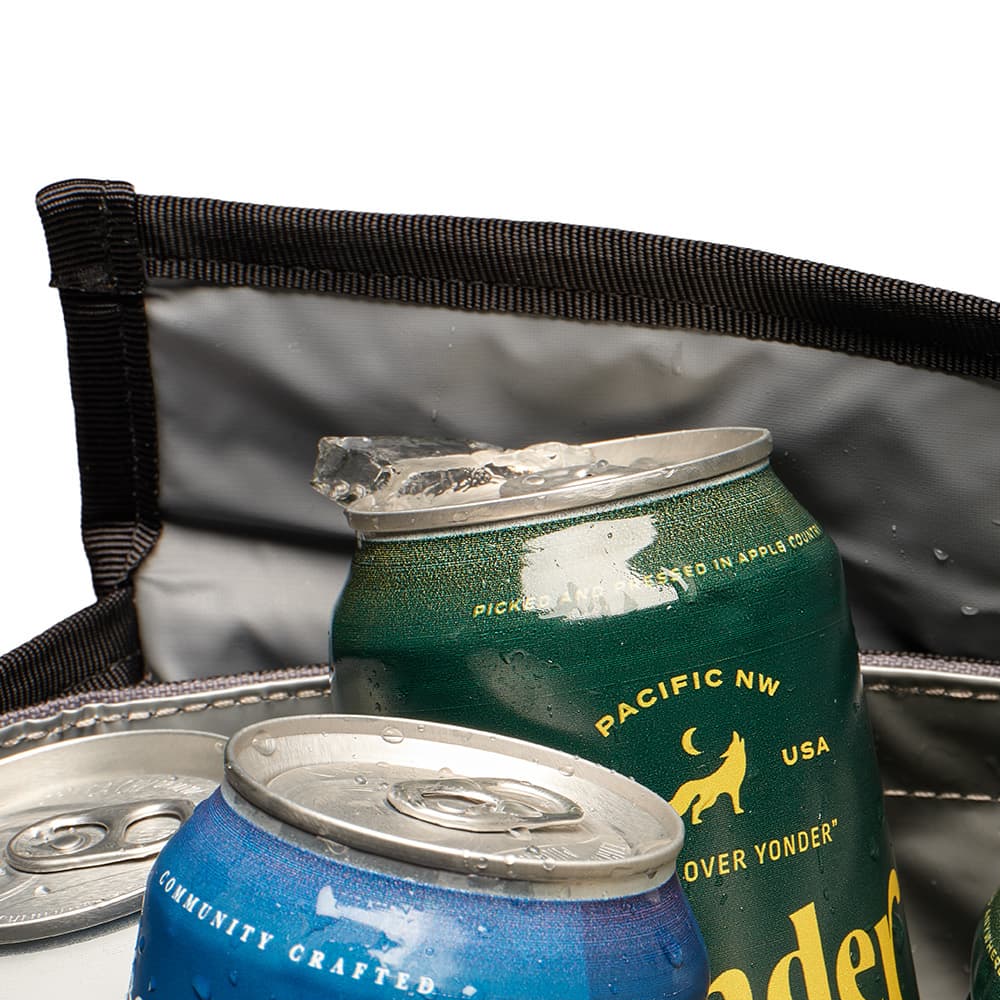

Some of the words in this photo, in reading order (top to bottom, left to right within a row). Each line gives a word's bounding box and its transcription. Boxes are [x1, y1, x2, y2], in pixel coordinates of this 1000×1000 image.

[711, 555, 733, 571] IN
[737, 539, 787, 564] APPLE
[594, 668, 723, 738] PACIFIC
[734, 670, 780, 697] NW
[781, 735, 830, 766] USA
[683, 848, 748, 883] OVER
[753, 818, 839, 865] YONDER"
[159, 870, 275, 950] COMMUNITY
[288, 944, 436, 995] CRAFTED
